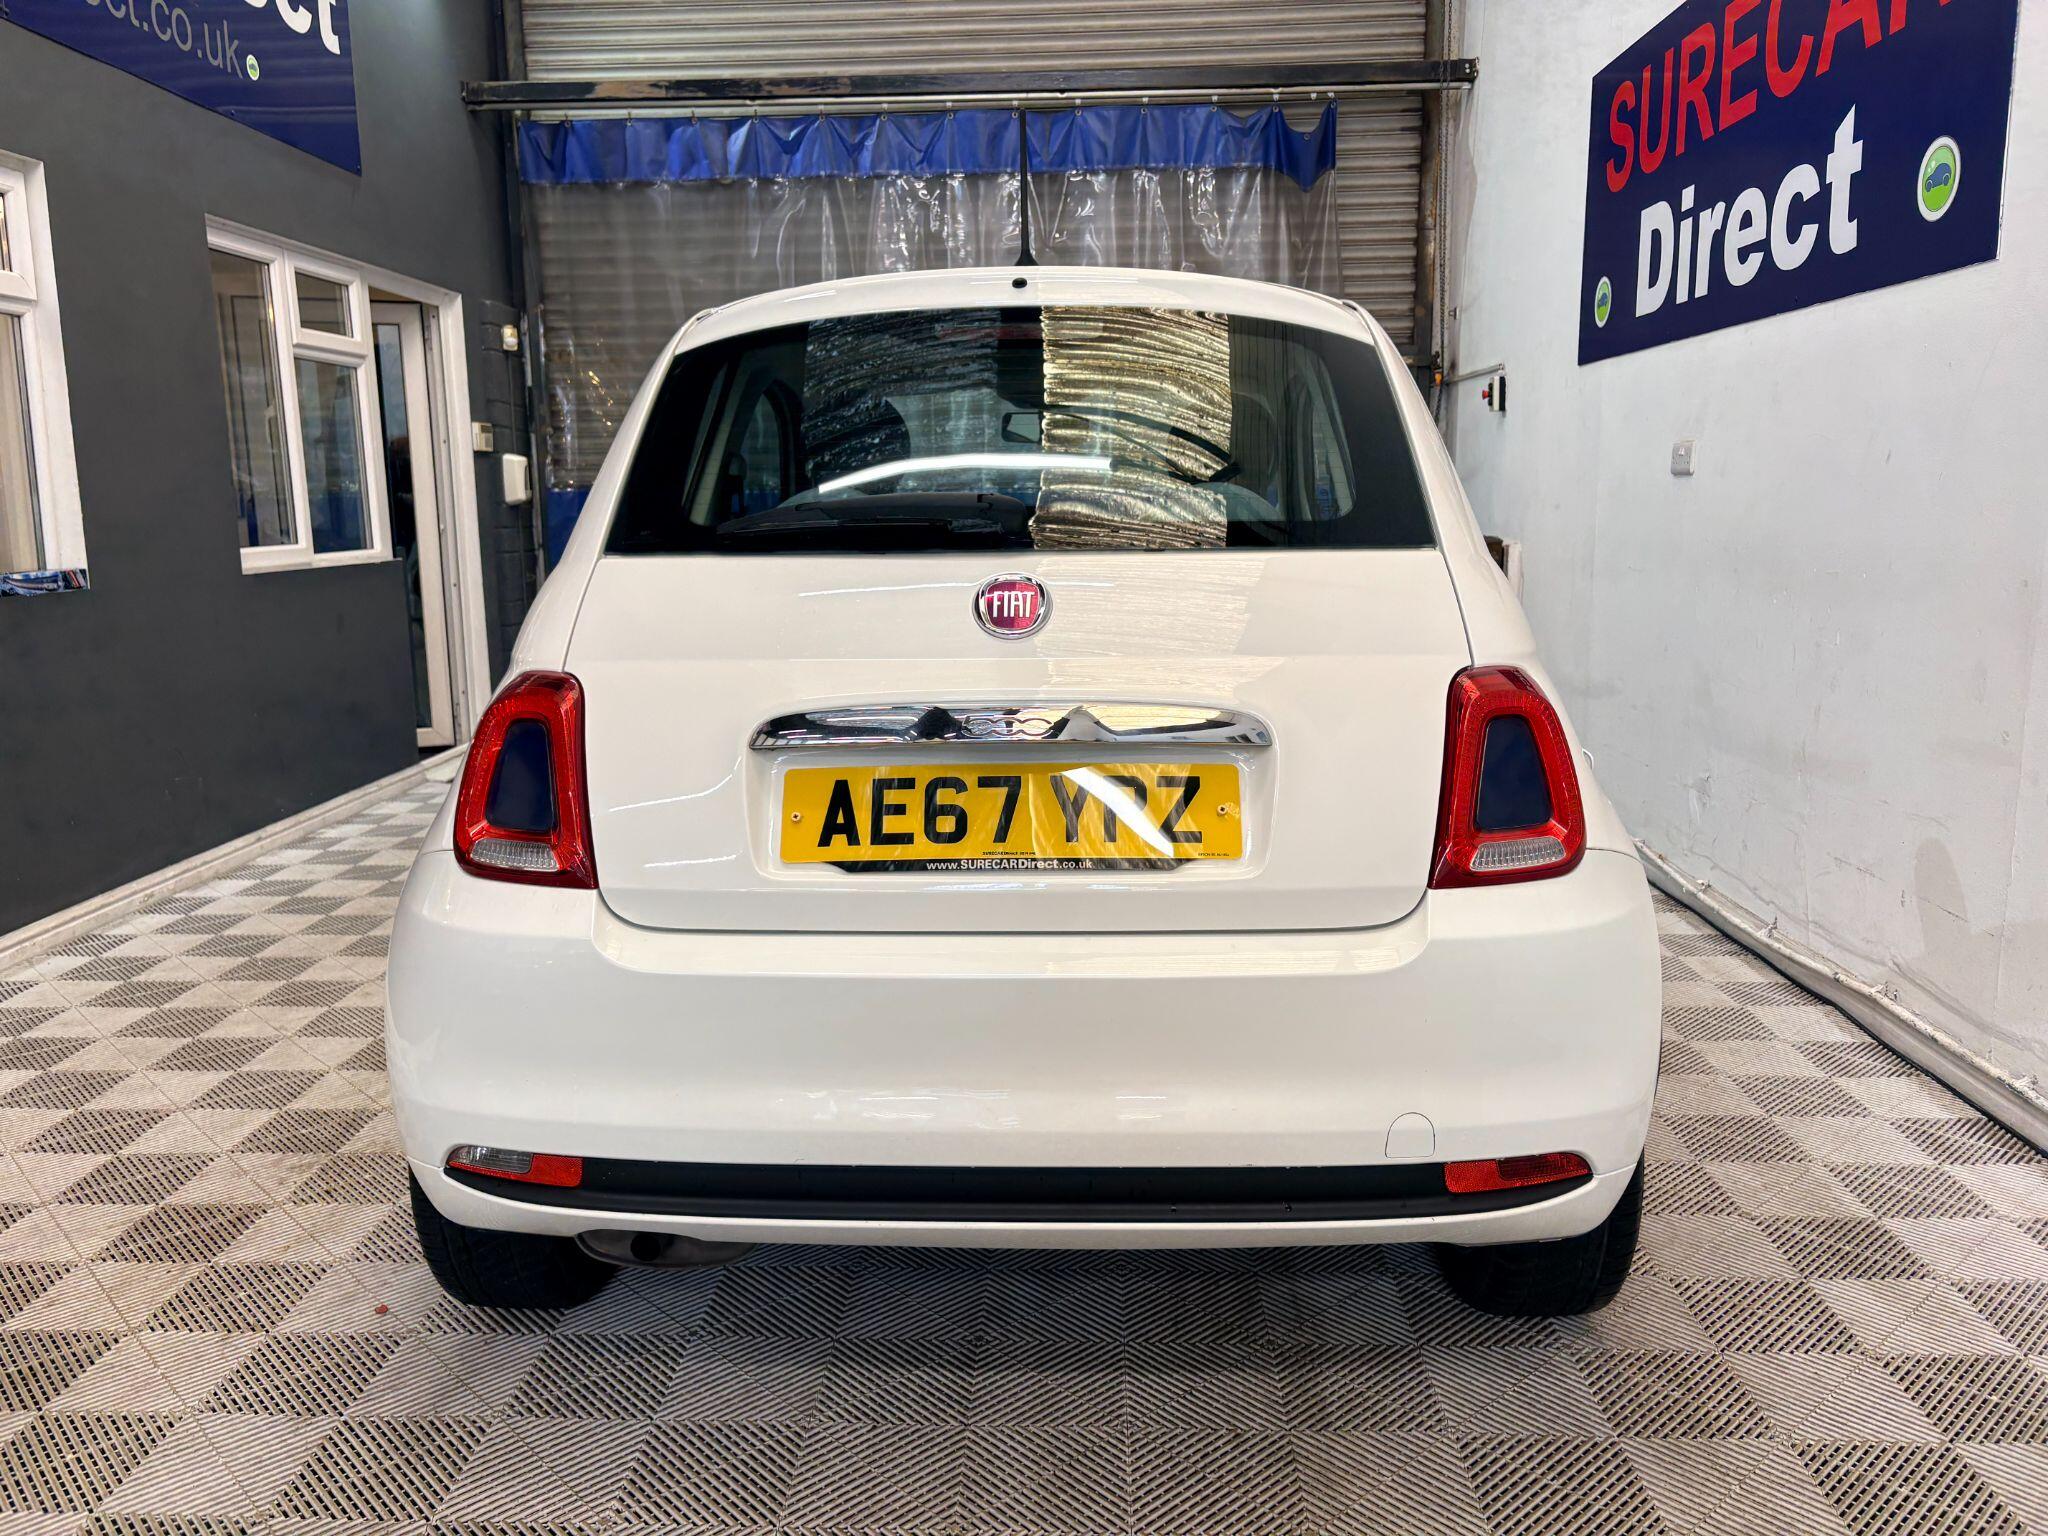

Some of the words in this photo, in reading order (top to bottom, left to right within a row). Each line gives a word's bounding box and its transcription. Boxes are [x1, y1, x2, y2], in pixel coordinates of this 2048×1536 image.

[1606, 0, 1951, 193] SURECA
[1635, 103, 1863, 318] Direct
[993, 591, 1035, 618] FIAT
[818, 776, 1021, 847] AE67
[1050, 775, 1202, 843] YPZ
[926, 858, 1093, 870] www.SURECARDirect.co.uk
